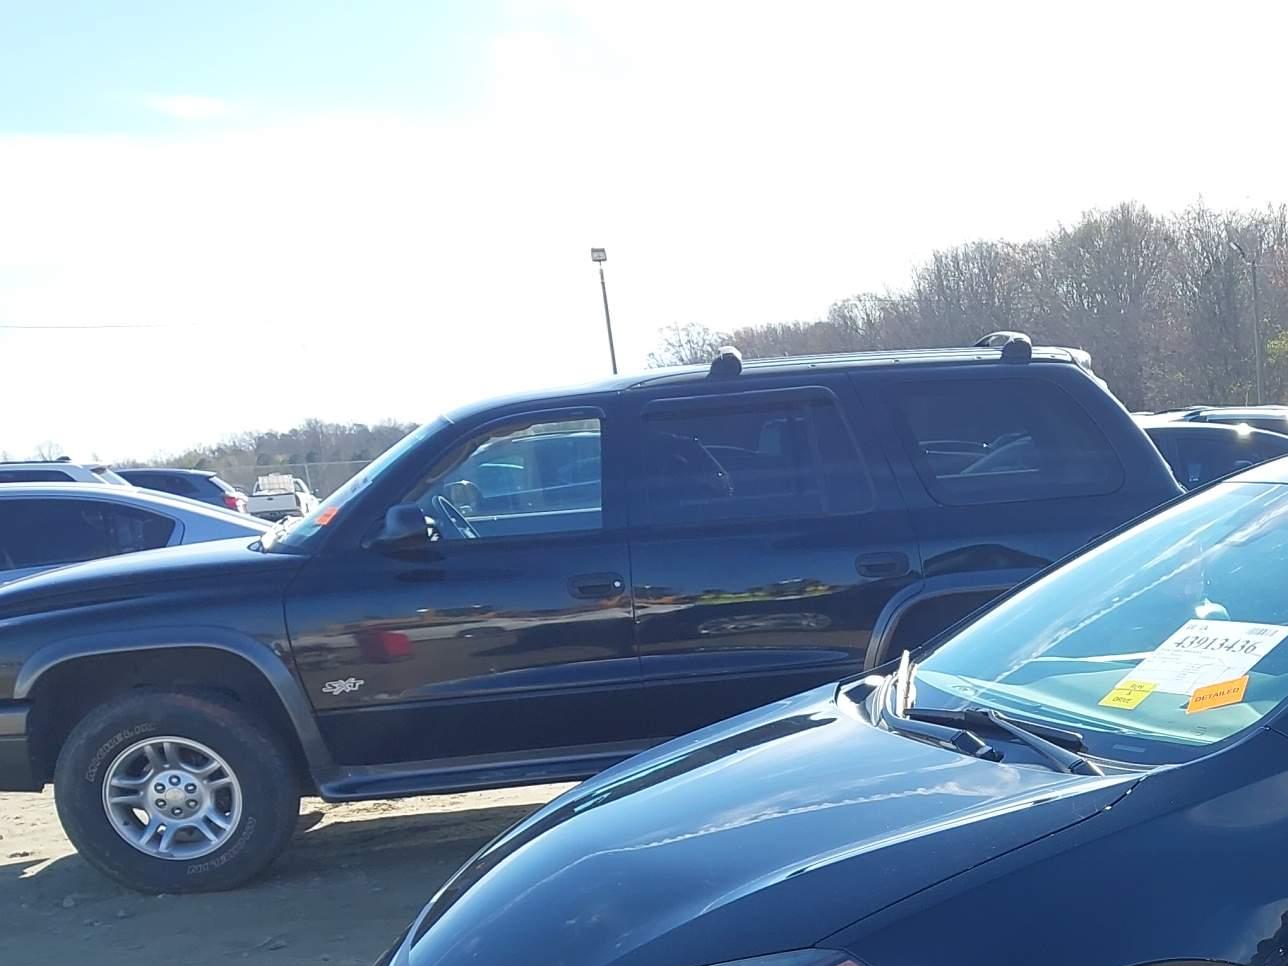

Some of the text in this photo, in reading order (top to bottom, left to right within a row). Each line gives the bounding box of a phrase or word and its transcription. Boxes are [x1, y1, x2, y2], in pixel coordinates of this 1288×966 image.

[1174, 635, 1258, 655] 43913436
[322, 677, 364, 695] SXT
[1194, 687, 1240, 702] DETAILED
